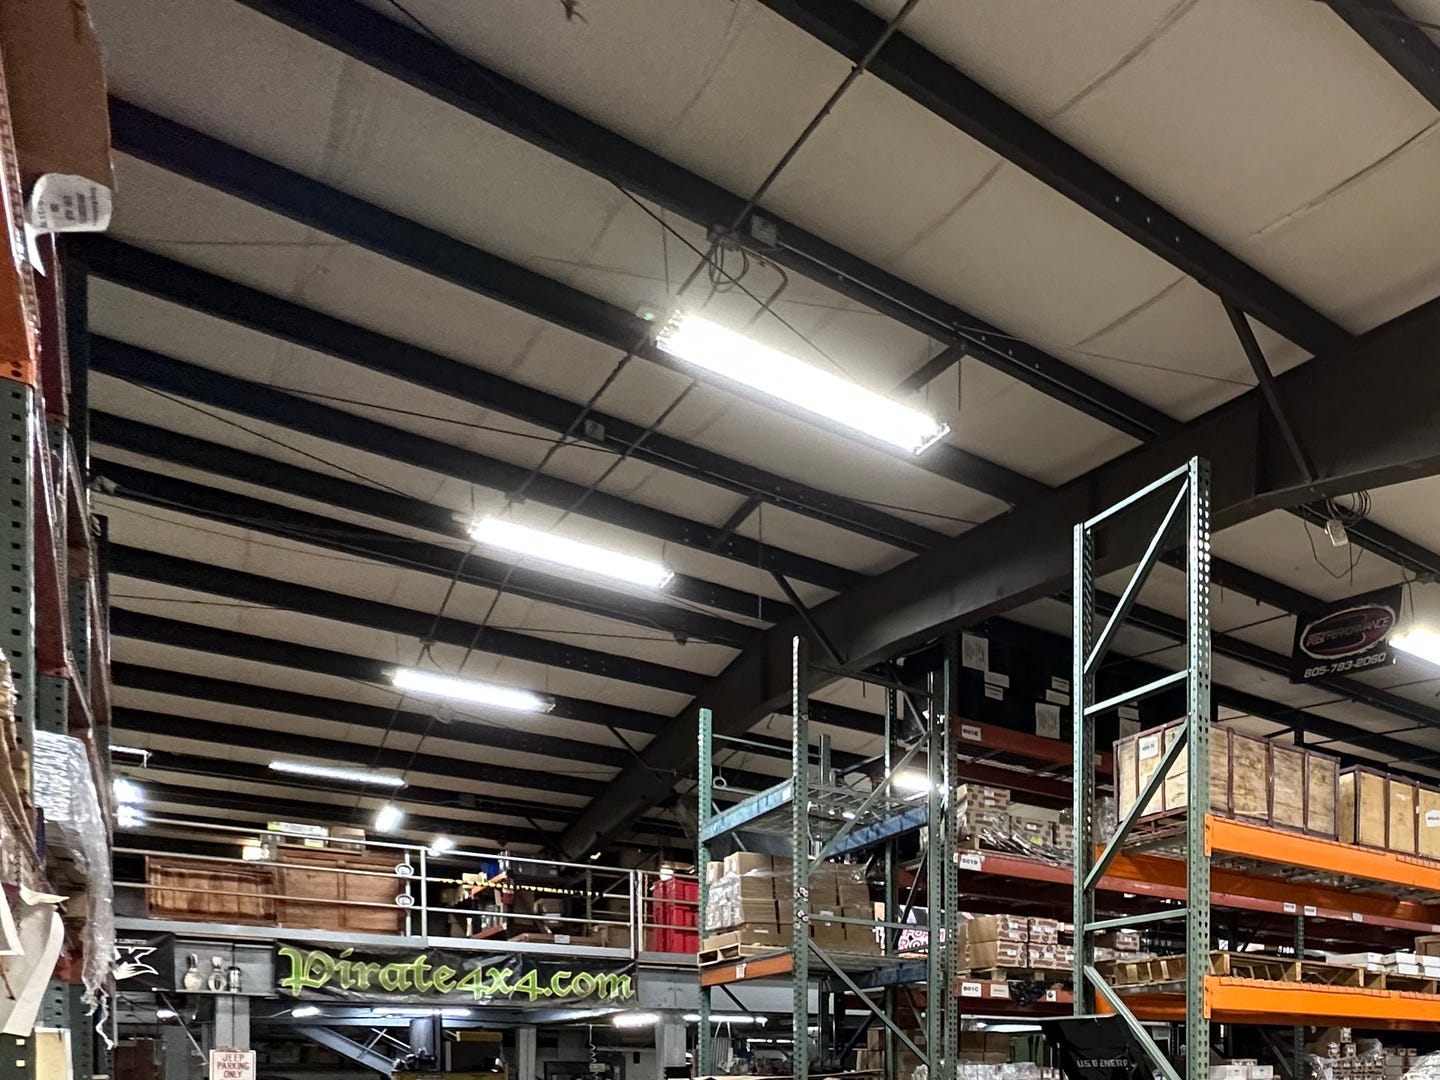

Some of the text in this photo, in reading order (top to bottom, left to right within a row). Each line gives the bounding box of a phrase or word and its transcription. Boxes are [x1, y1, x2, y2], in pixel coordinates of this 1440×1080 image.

[278, 947, 635, 1000] Pirate4x4.com
[222, 1053, 245, 1062] JEEP
[216, 1061, 250, 1070] PARKING
[223, 1070, 242, 1079] ONLY
